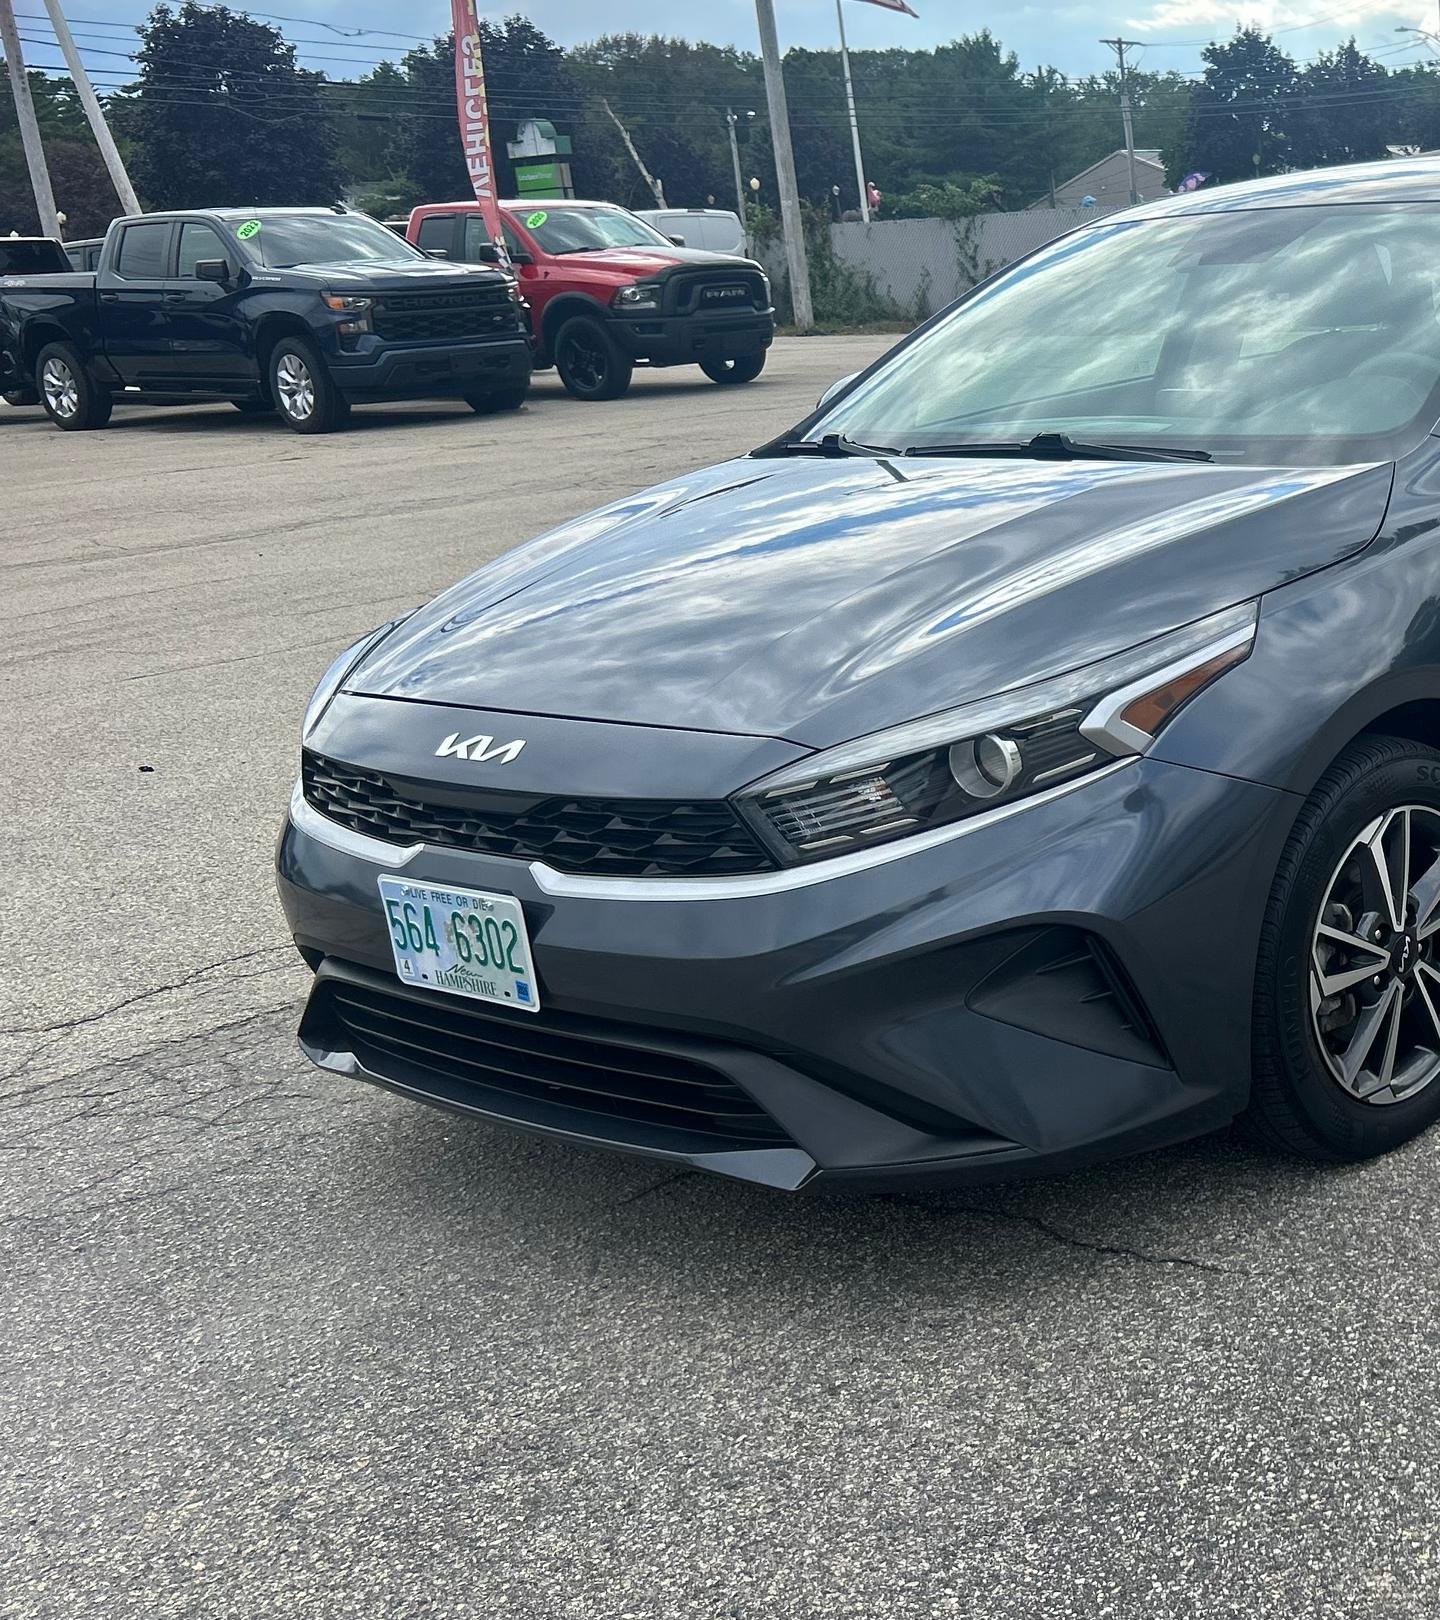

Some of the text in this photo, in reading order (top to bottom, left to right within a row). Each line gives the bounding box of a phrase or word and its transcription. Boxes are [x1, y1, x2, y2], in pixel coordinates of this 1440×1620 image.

[240, 221, 259, 237] 2022
[410, 887, 487, 911] LIVE FREE OR DIE
[385, 899, 525, 974] 564 6302
[404, 960, 411, 972] 4
[435, 969, 499, 996] HAMPSHIRE
